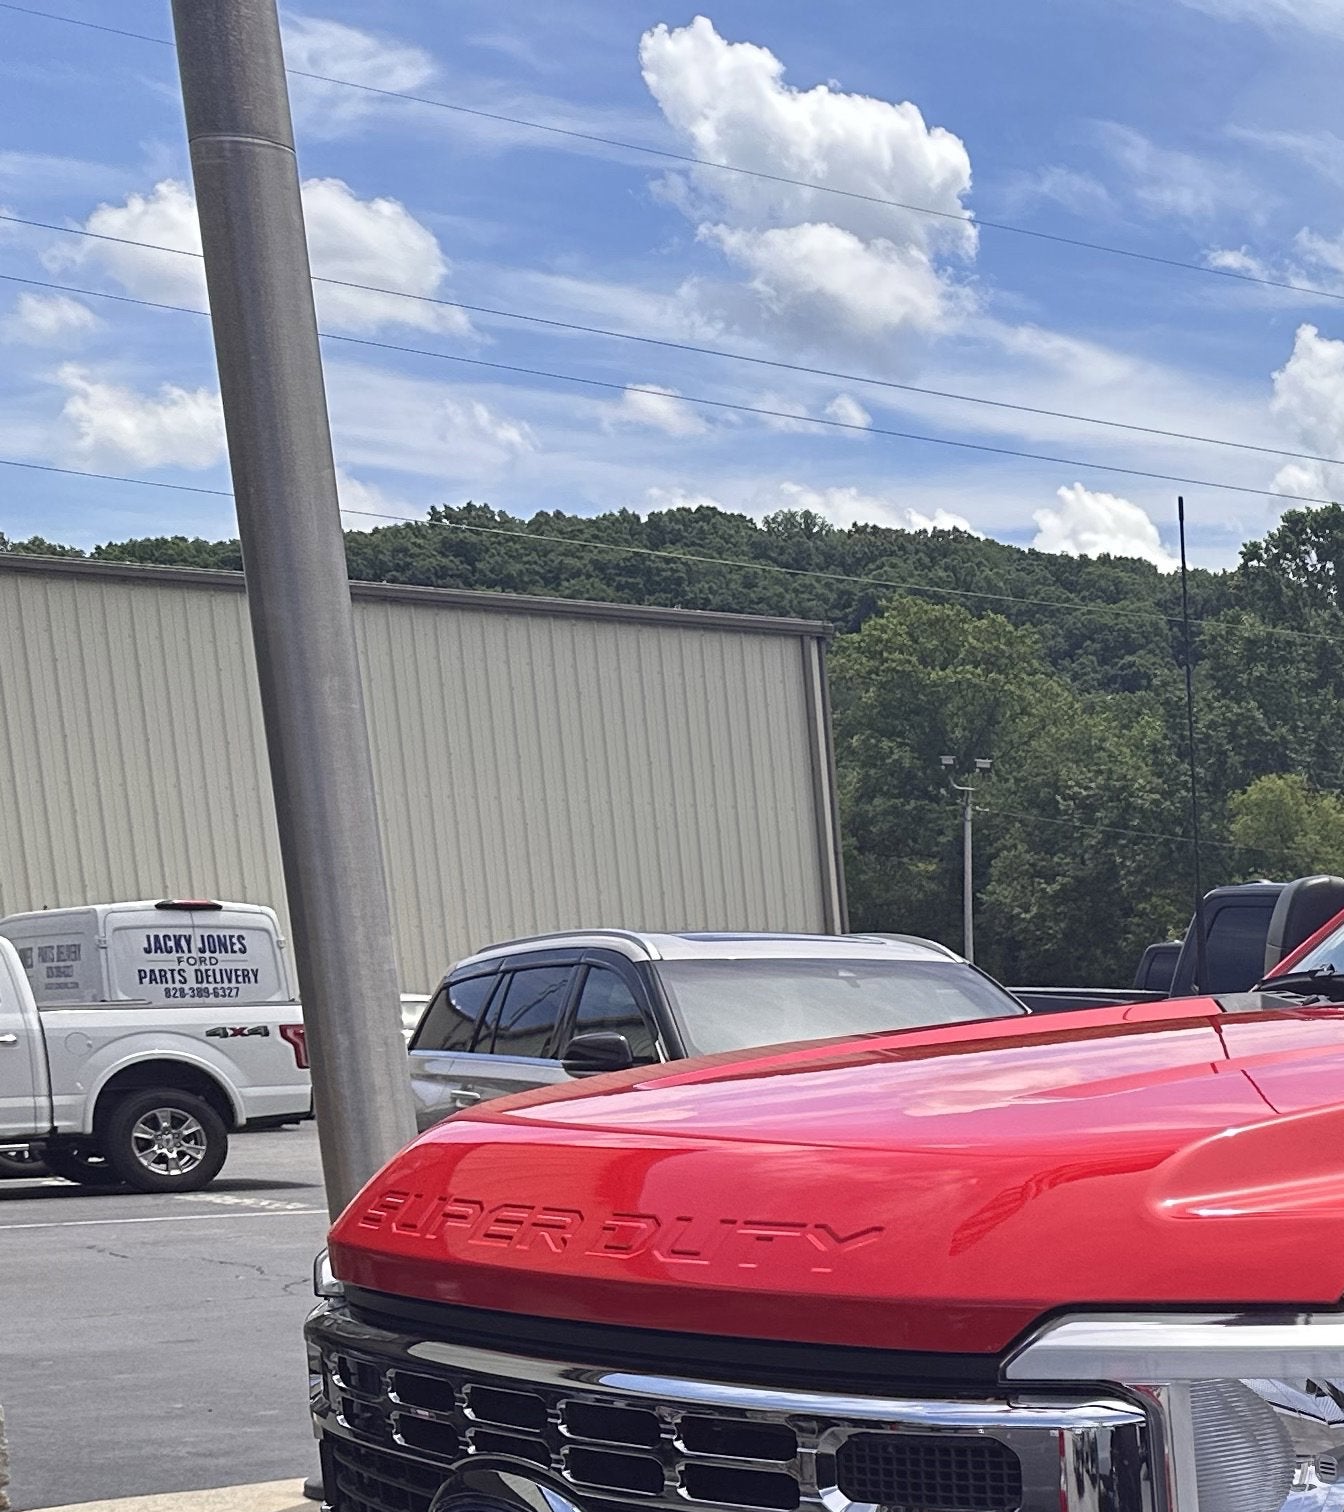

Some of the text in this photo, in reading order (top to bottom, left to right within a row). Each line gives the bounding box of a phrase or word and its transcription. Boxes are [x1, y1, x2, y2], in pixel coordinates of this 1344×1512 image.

[143, 934, 247, 954] JACKY JONES
[176, 956, 219, 966] FORD
[137, 968, 259, 985] PARTS DELIVERY
[164, 986, 240, 998] 828-389-6327
[357, 1190, 886, 1273] SUPER DUTY
